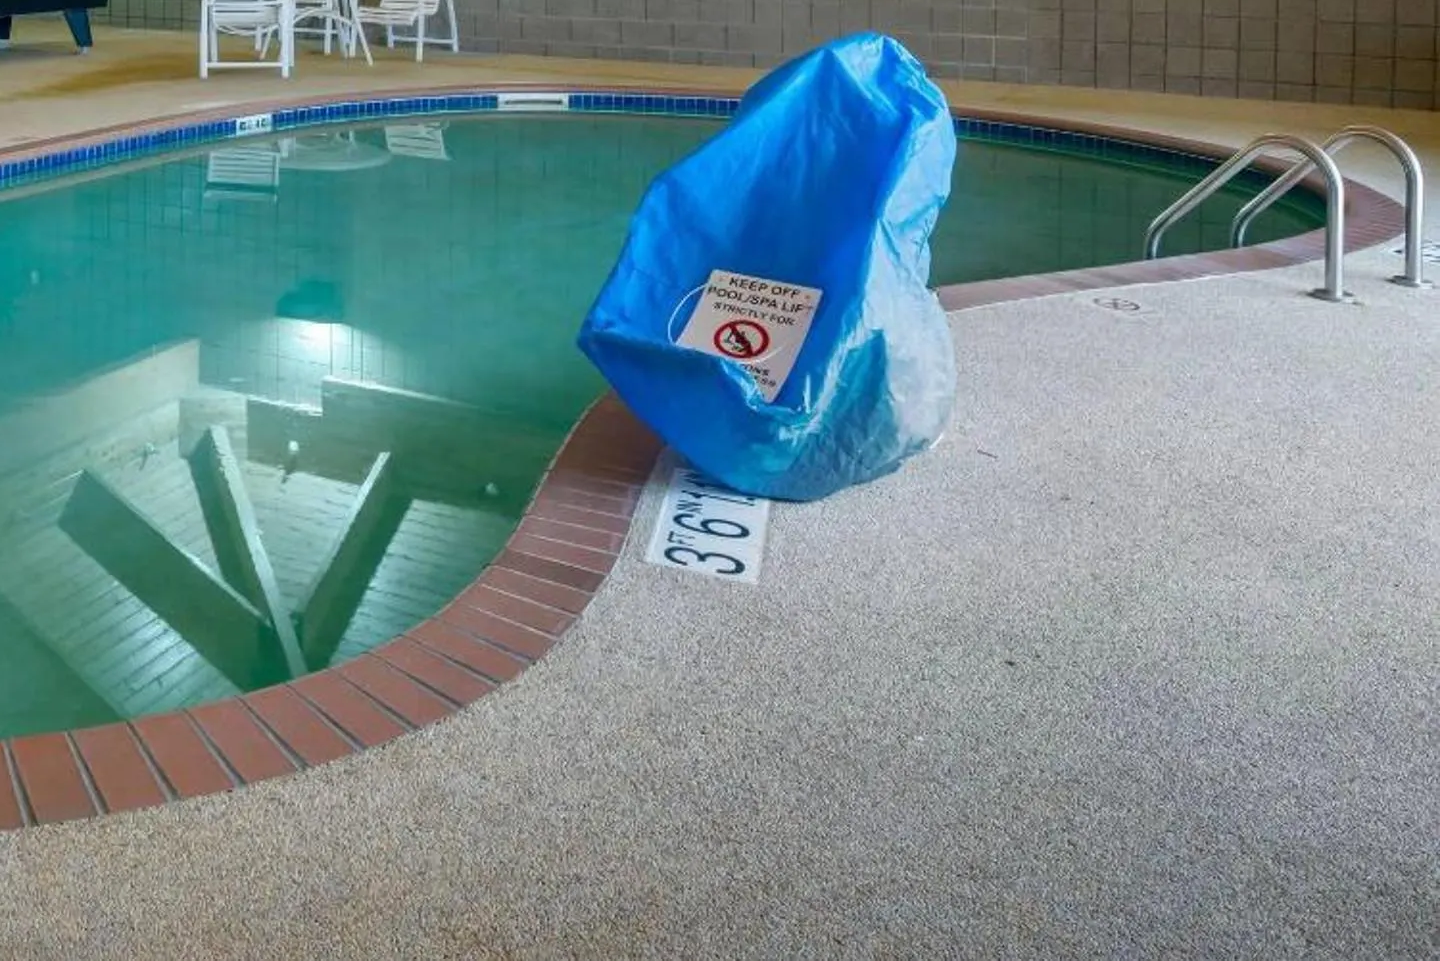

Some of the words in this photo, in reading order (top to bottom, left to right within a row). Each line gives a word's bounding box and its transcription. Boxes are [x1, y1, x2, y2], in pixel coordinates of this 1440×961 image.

[707, 285, 778, 310] POOL/SPA
[729, 277, 768, 293] KEEP
[771, 285, 801, 300] OFF
[713, 301, 766, 320] STRICTLY
[769, 312, 797, 326] FOR
